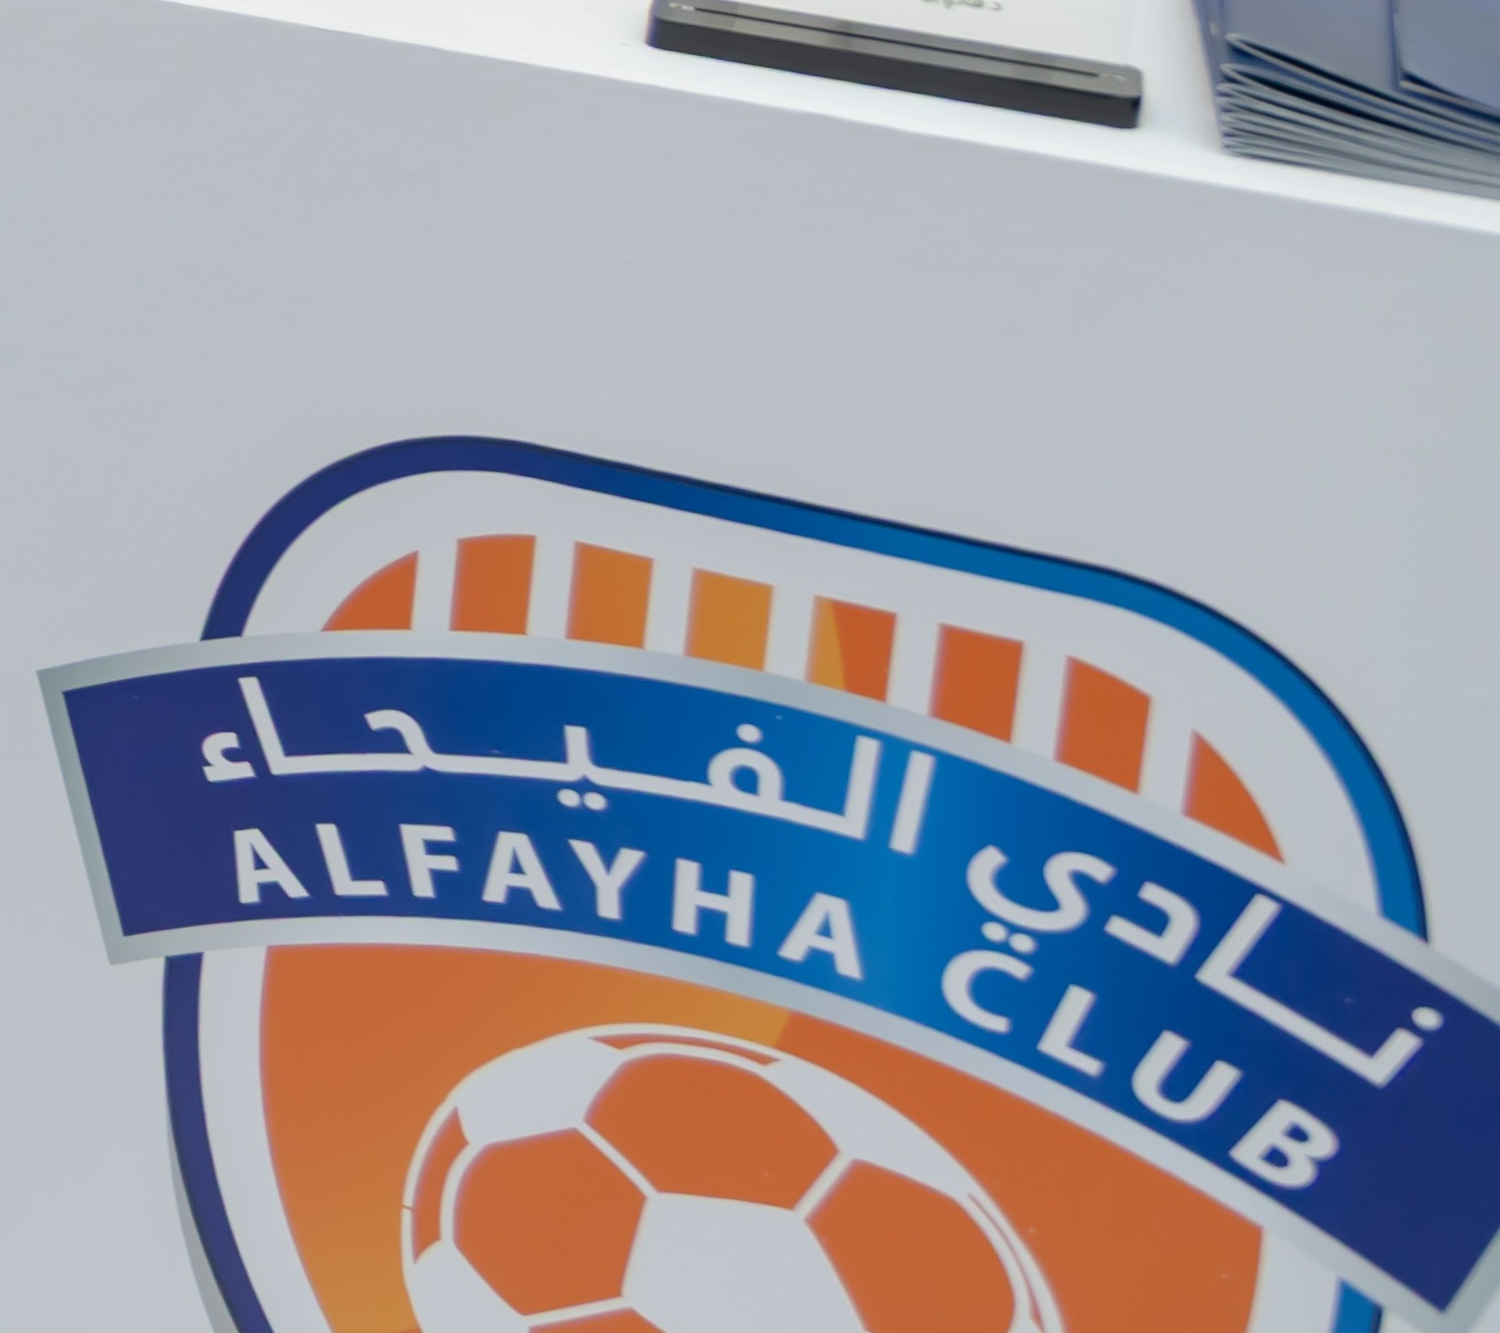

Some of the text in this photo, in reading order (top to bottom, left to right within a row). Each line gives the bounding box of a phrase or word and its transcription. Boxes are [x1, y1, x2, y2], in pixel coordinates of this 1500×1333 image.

[201, 675, 1445, 1090] نادي الفيحاء
[232, 820, 1341, 1190] ALFAYHA CLUB
